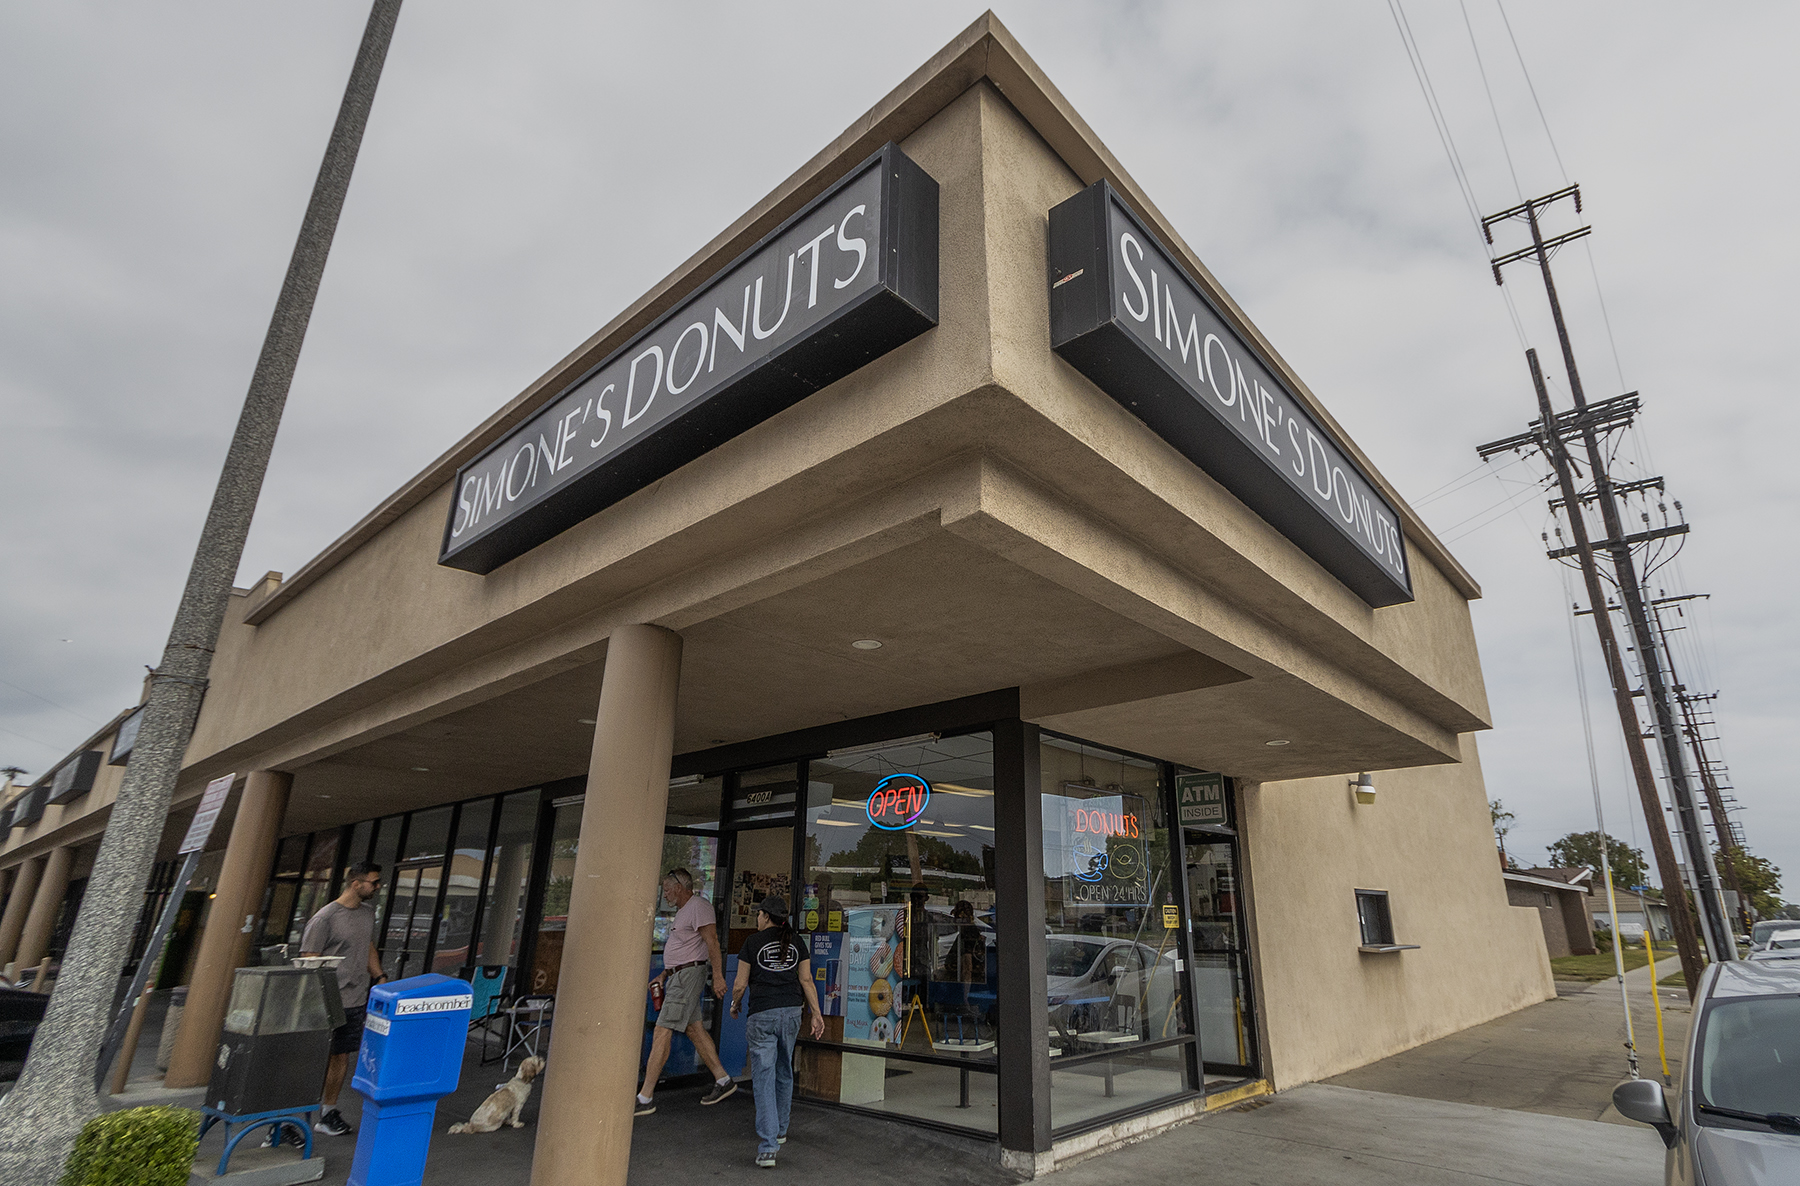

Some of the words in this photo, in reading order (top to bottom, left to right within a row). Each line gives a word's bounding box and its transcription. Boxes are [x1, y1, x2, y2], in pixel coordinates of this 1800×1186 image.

[452, 383, 615, 538] SIMONE'S
[621, 204, 867, 429] DONUTS
[1120, 232, 1305, 477] SIMONE'S
[1305, 425, 1404, 575] DONUTS
[869, 785, 924, 817] OPEN
[1181, 785, 1220, 803] ATM
[1075, 808, 1139, 839] DONUTS
[1184, 806, 1220, 817] INSIDE
[1079, 884, 1109, 902] OPEN
[397, 998, 471, 1014] beachcomber
